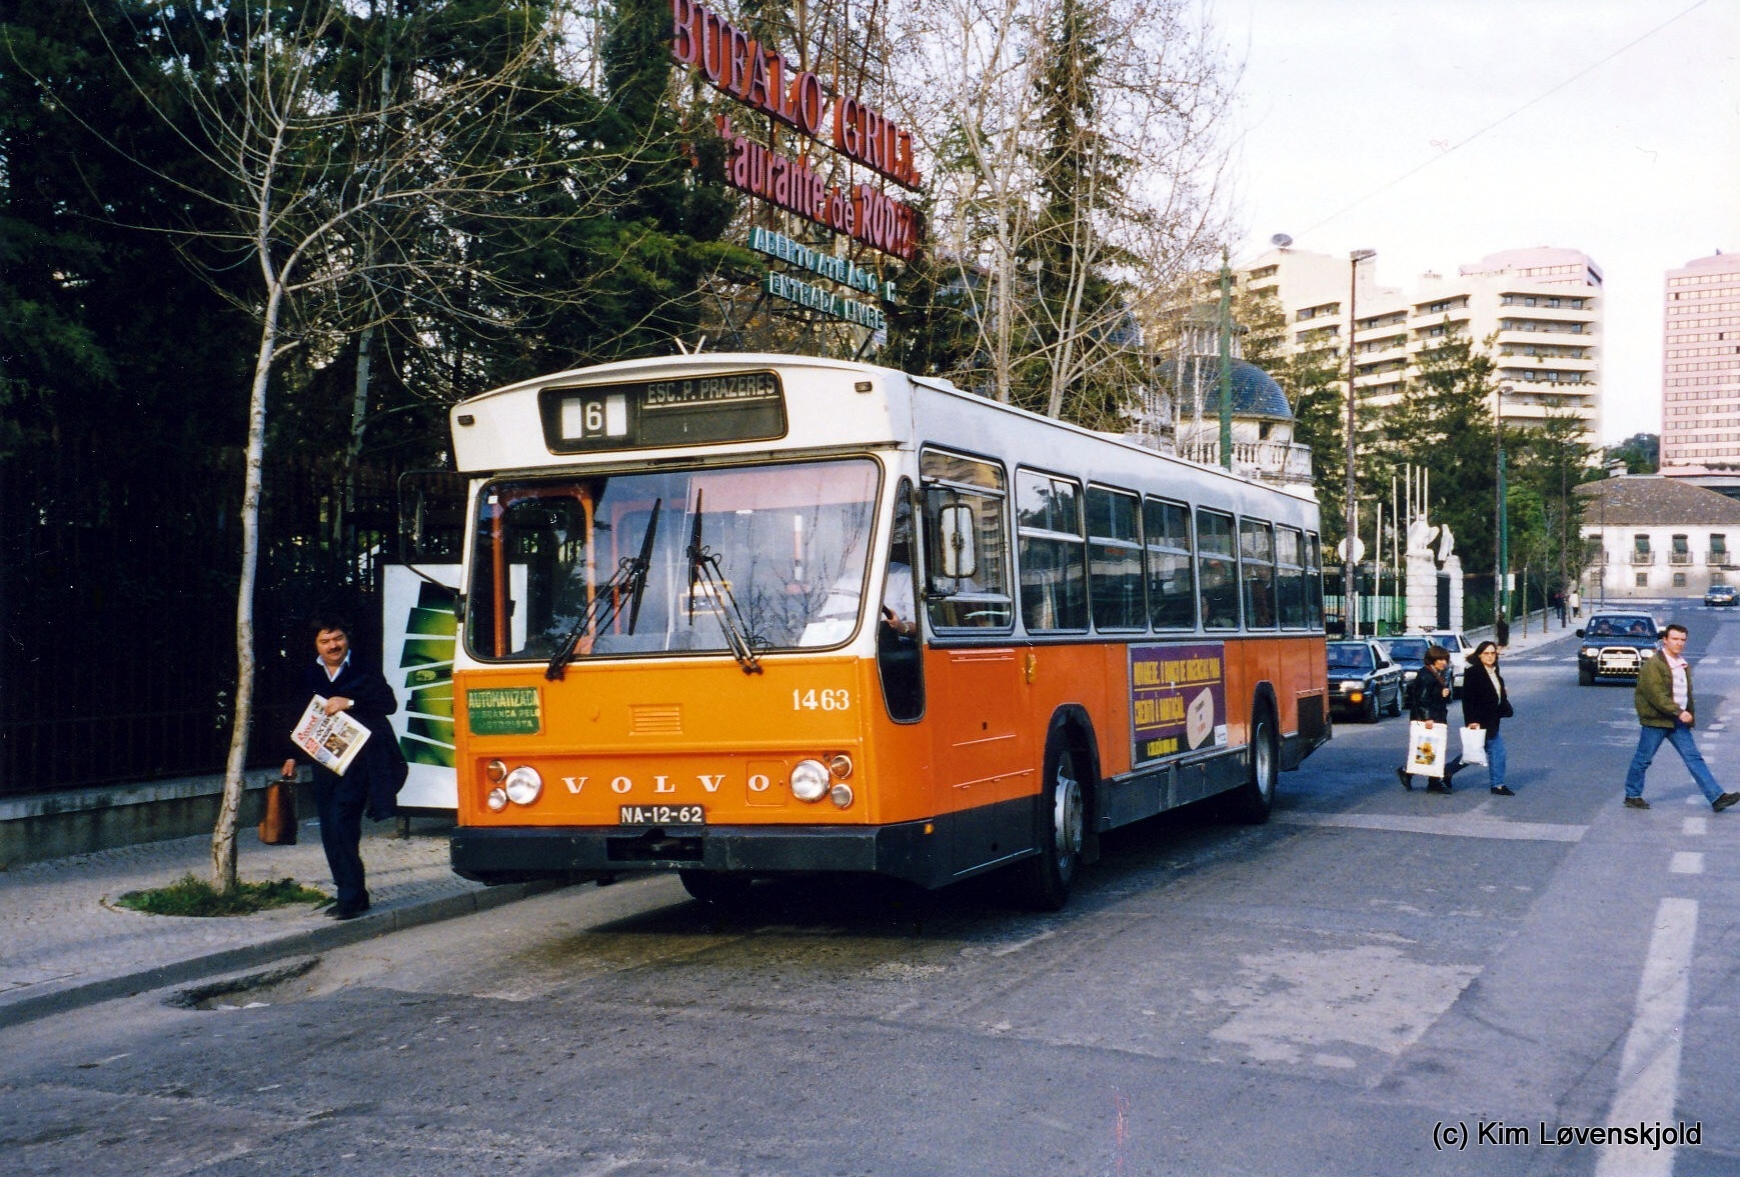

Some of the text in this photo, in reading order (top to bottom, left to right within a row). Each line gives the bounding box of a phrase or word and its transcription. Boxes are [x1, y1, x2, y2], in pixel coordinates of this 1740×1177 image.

[832, 190, 855, 235] de
[753, 226, 816, 271] ABERTO
[700, 375, 775, 399] PRAZERES
[585, 402, 602, 430] 6
[792, 689, 850, 711] 1463
[561, 774, 770, 794] VOLVO
[620, 806, 703, 824] NA-12-62
